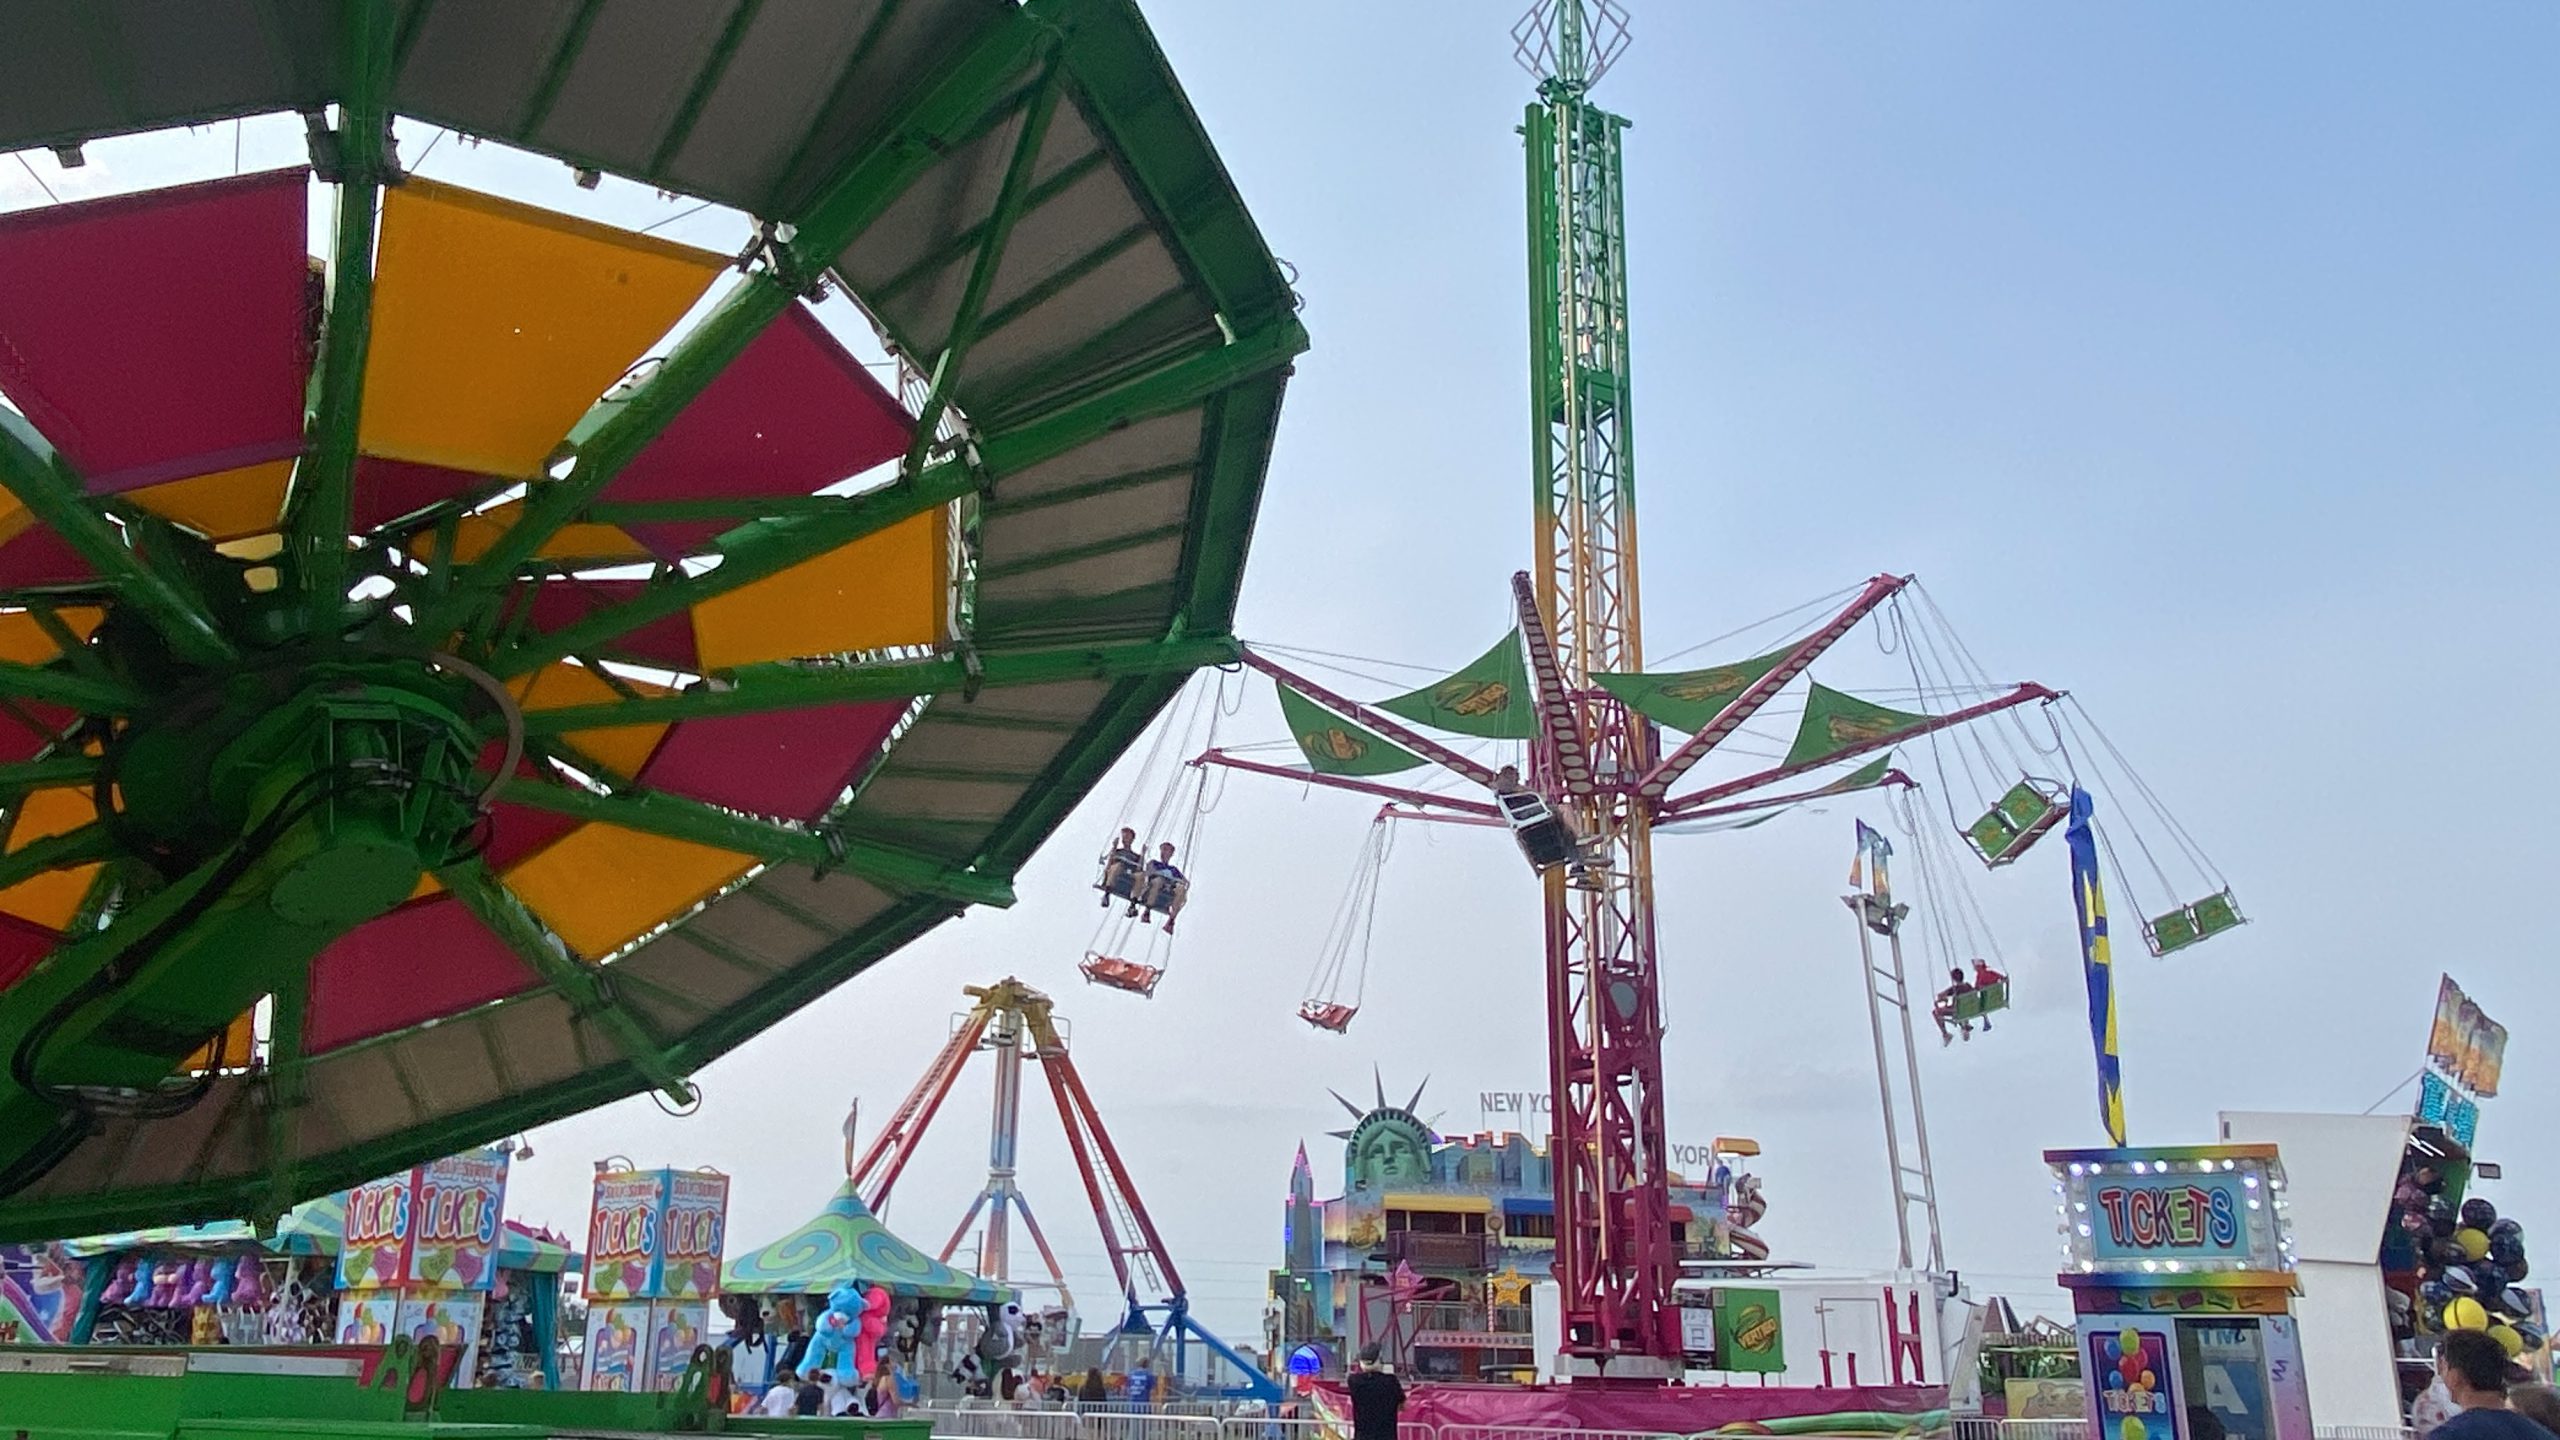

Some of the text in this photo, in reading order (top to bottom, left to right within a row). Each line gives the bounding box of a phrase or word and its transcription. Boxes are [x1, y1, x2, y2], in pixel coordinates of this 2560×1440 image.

[1480, 1092, 1523, 1112] NEW
[347, 1185, 411, 1241] TICKETS
[420, 1184, 497, 1244] TICKETS
[596, 1204, 656, 1256] TICKETS
[666, 1206, 721, 1258] TICKETS
[2100, 1186, 2237, 1247] TICKETS
[2103, 1389, 2167, 1414] TICKETS
